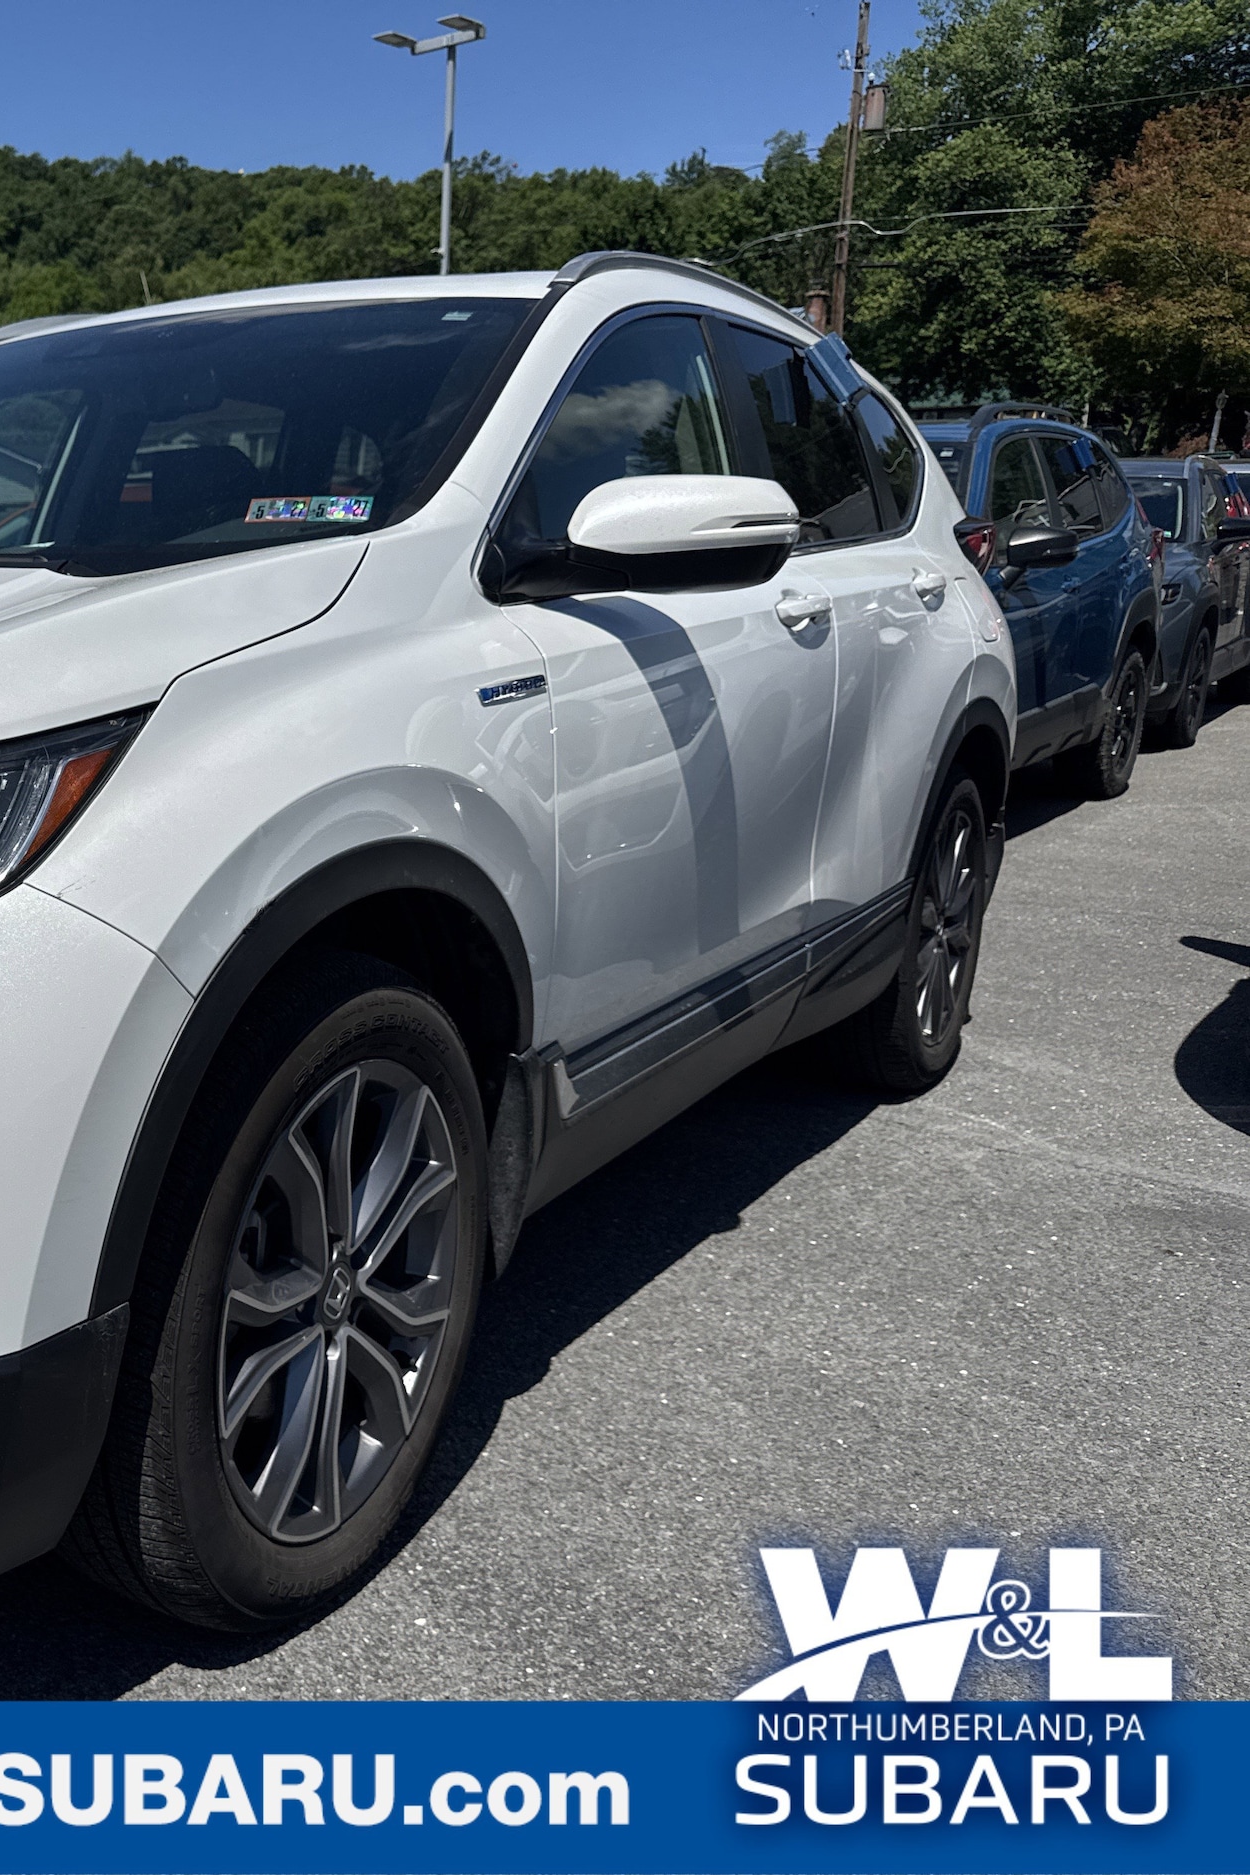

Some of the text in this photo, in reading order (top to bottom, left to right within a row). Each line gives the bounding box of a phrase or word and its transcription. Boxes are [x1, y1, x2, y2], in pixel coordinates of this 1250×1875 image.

[255, 505, 265, 519] 5
[315, 500, 368, 518] 5 27
